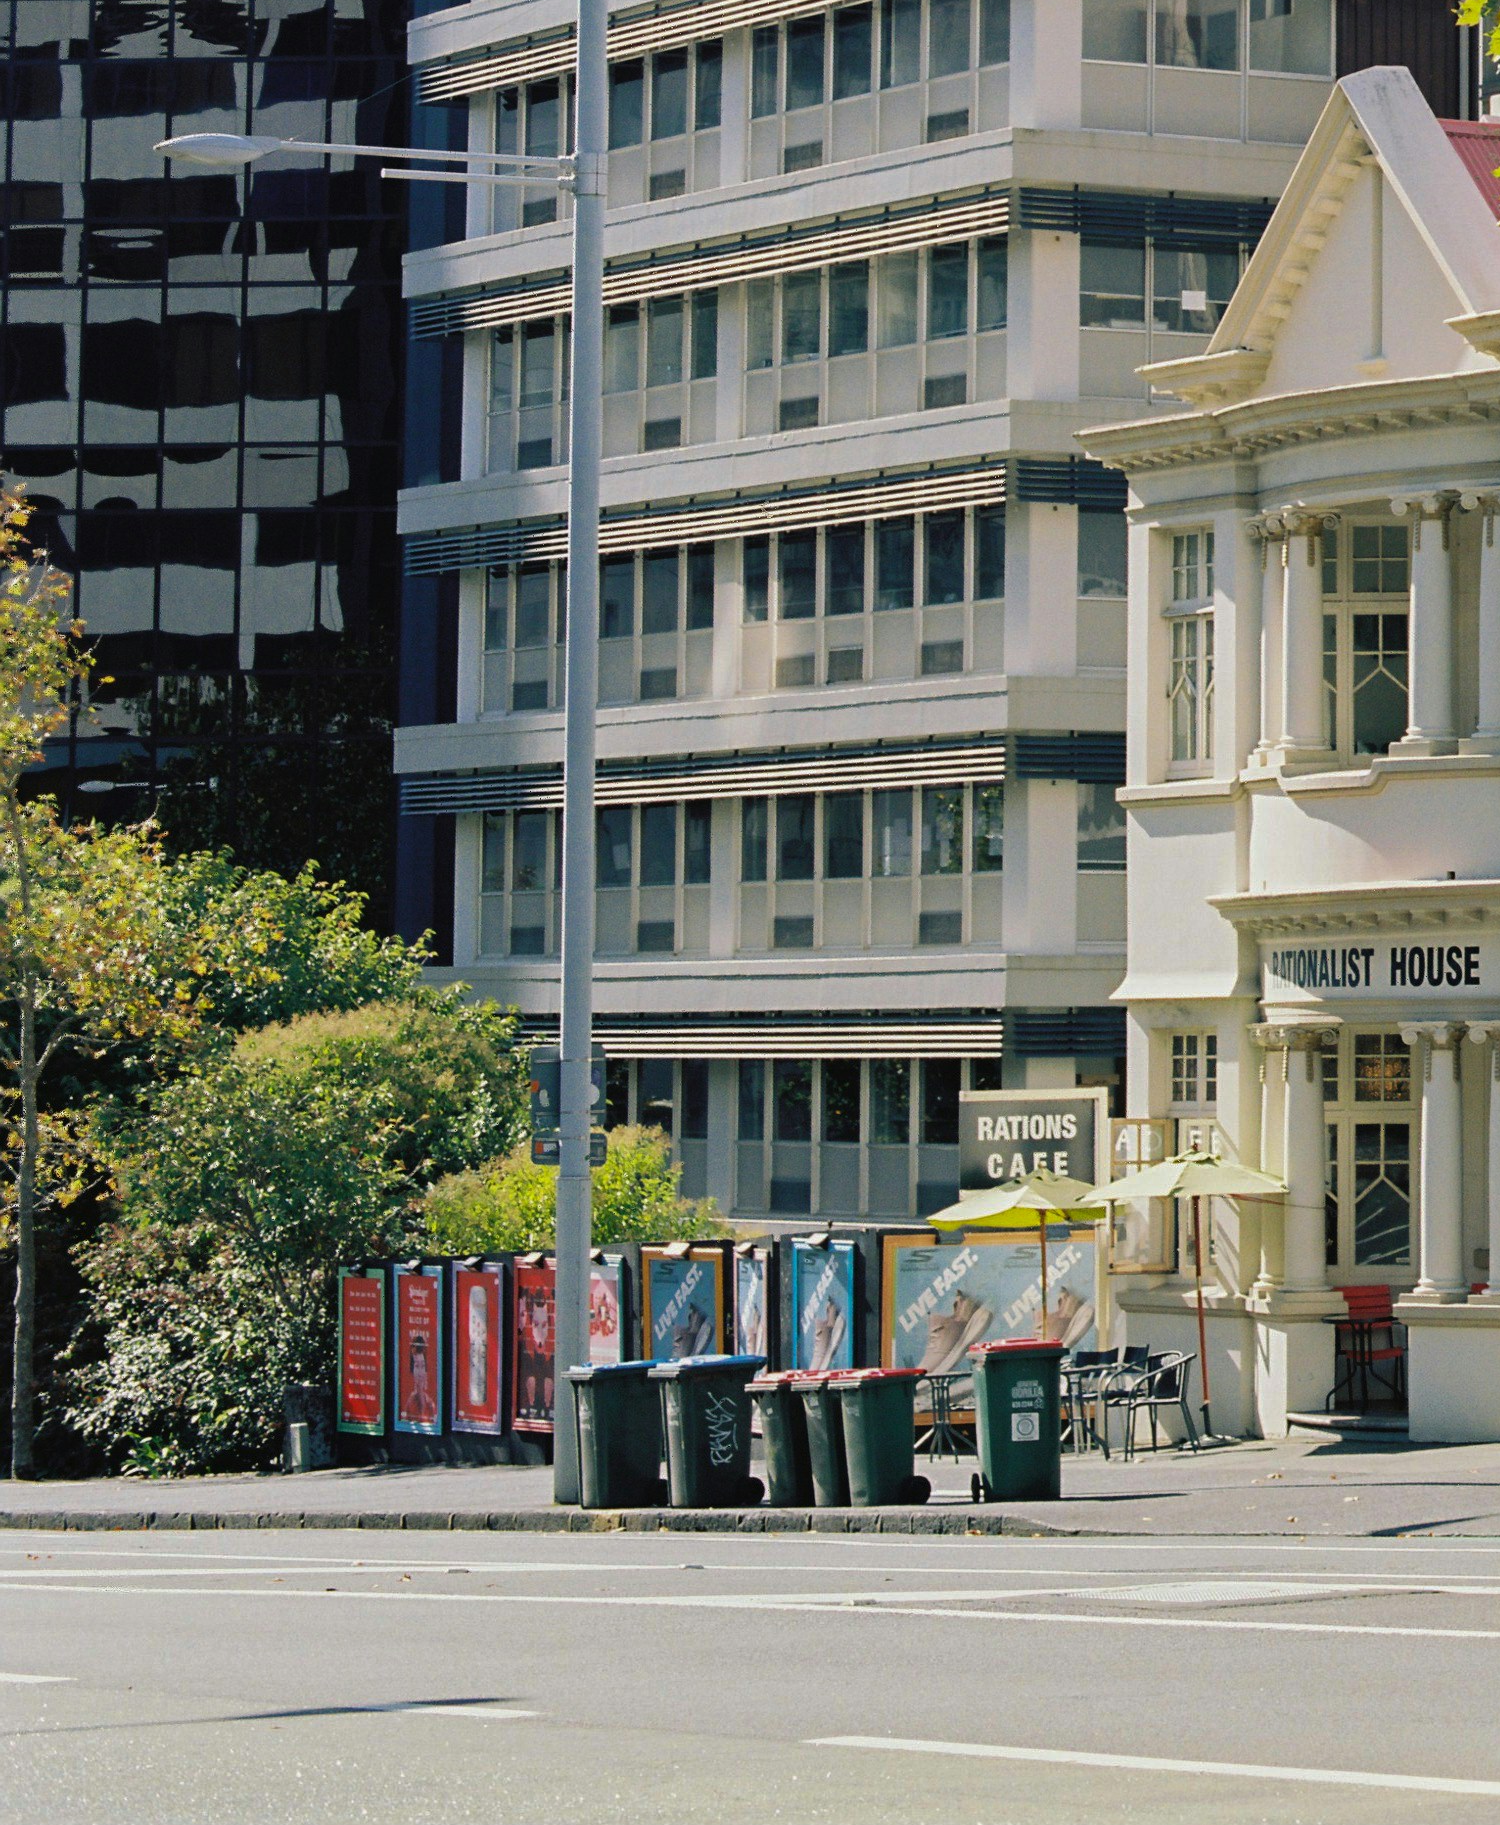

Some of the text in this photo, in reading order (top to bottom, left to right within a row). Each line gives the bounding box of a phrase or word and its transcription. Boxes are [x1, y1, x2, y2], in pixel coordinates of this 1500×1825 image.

[1272, 945, 1480, 989] RATIONALIST HOUSE
[977, 1113, 1077, 1141] RATIONS
[987, 1150, 1069, 1179] CAFE
[654, 1299, 679, 1341] LIVE
[674, 1262, 703, 1309] FAST.
[801, 1254, 839, 1334] LIVE FAST.
[898, 1287, 938, 1333] LIVE
[932, 1247, 979, 1297] FAST.
[1002, 1284, 1042, 1329] LIVE
